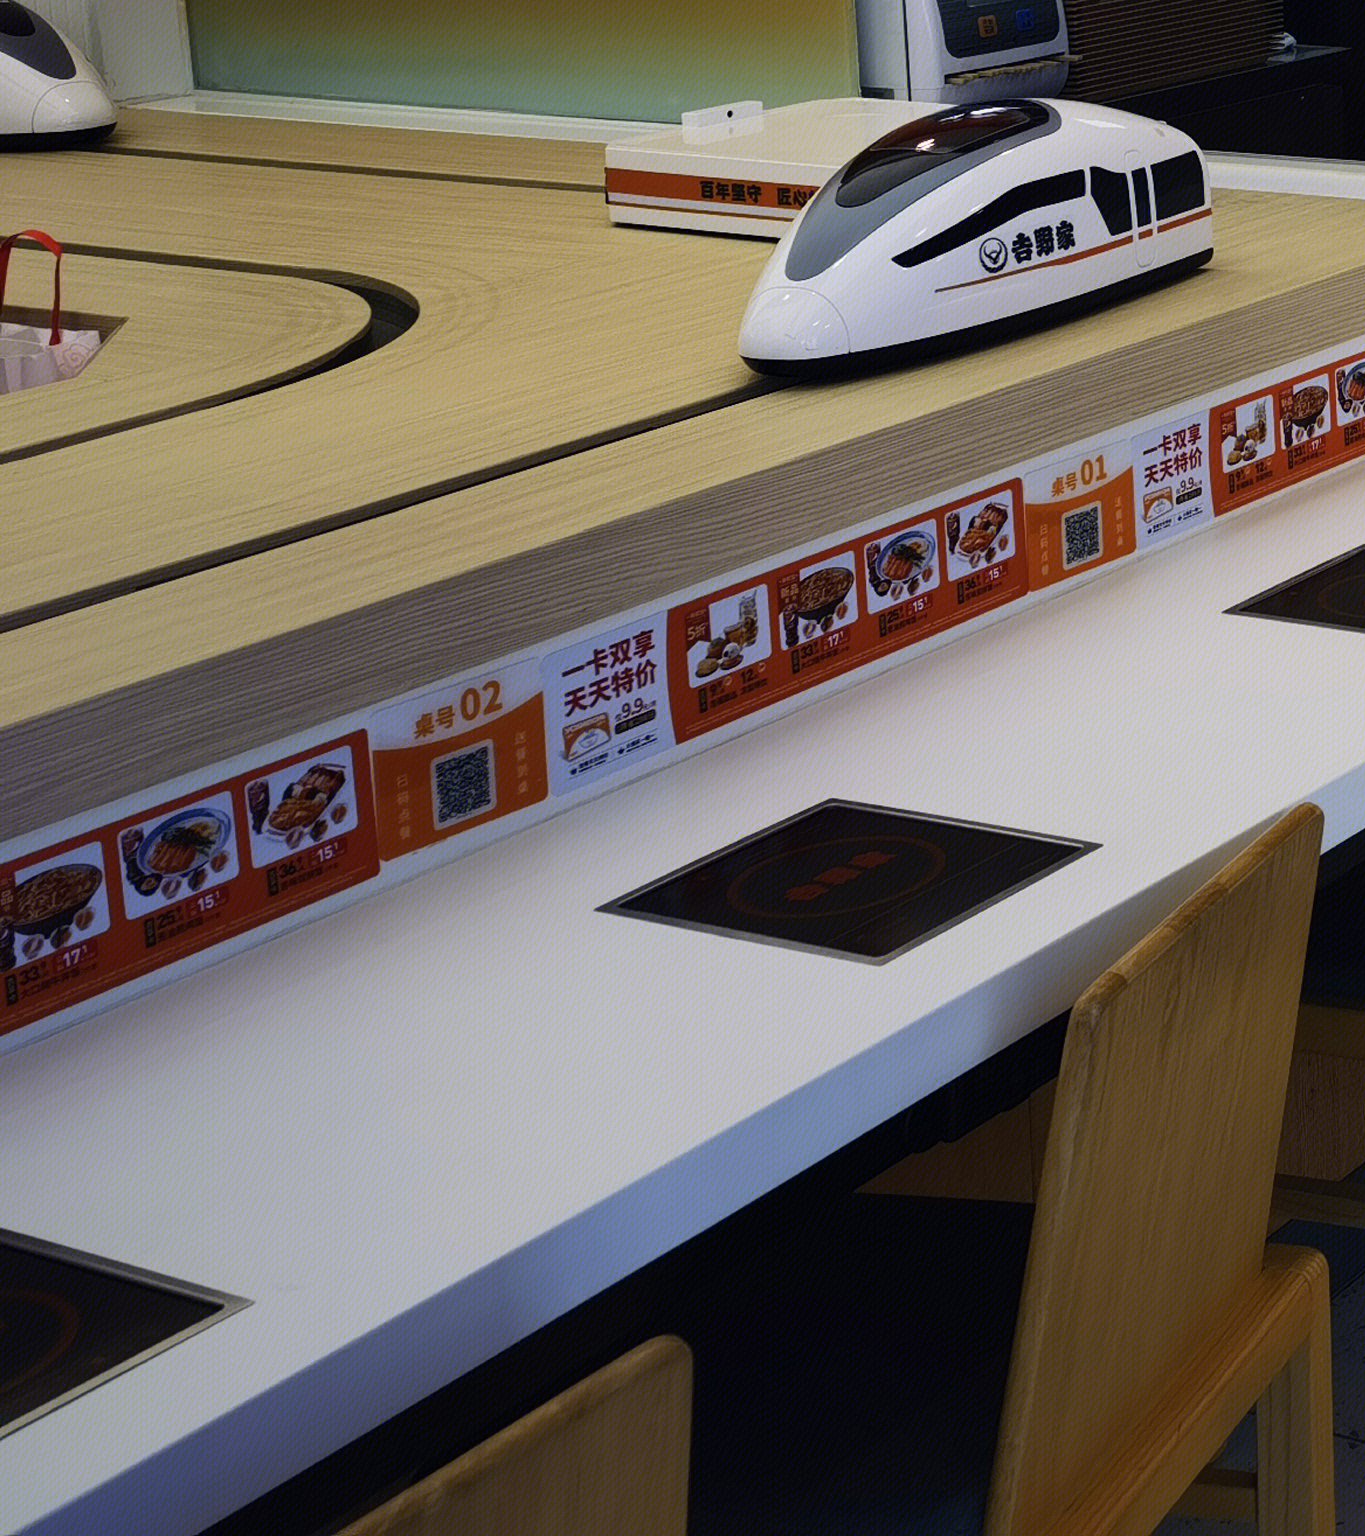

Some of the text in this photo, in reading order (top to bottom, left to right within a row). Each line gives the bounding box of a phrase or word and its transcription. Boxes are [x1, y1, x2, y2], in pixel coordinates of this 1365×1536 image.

[700, 180, 817, 207] 百年坚守 匠心
[1143, 423, 1202, 456] 一卡双享
[1080, 454, 1108, 486] 01
[1144, 447, 1203, 488] 天天特价
[561, 629, 656, 678] 一卡双享
[564, 659, 658, 718] 天天特价
[414, 680, 504, 740] 桌号 02
